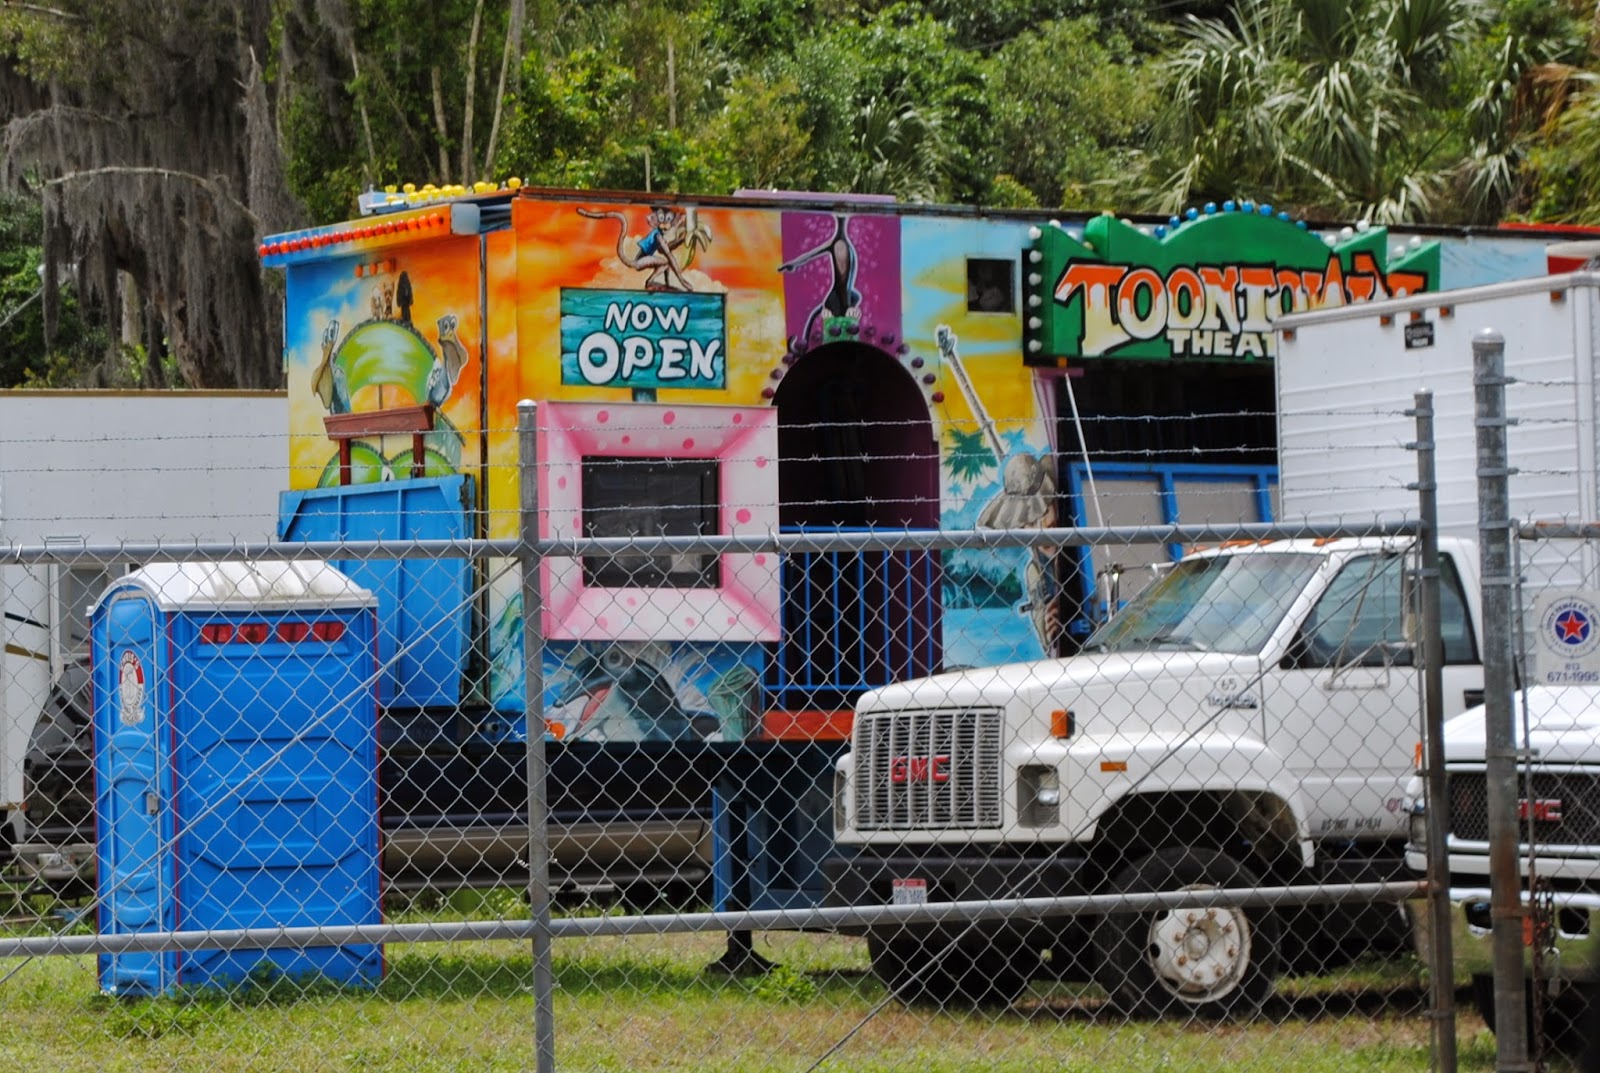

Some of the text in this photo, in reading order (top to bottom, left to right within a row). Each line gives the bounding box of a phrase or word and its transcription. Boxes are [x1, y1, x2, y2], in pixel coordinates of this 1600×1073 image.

[604, 301, 690, 333] NOW
[577, 331, 722, 385] OPEN
[891, 755, 949, 783] GMC
